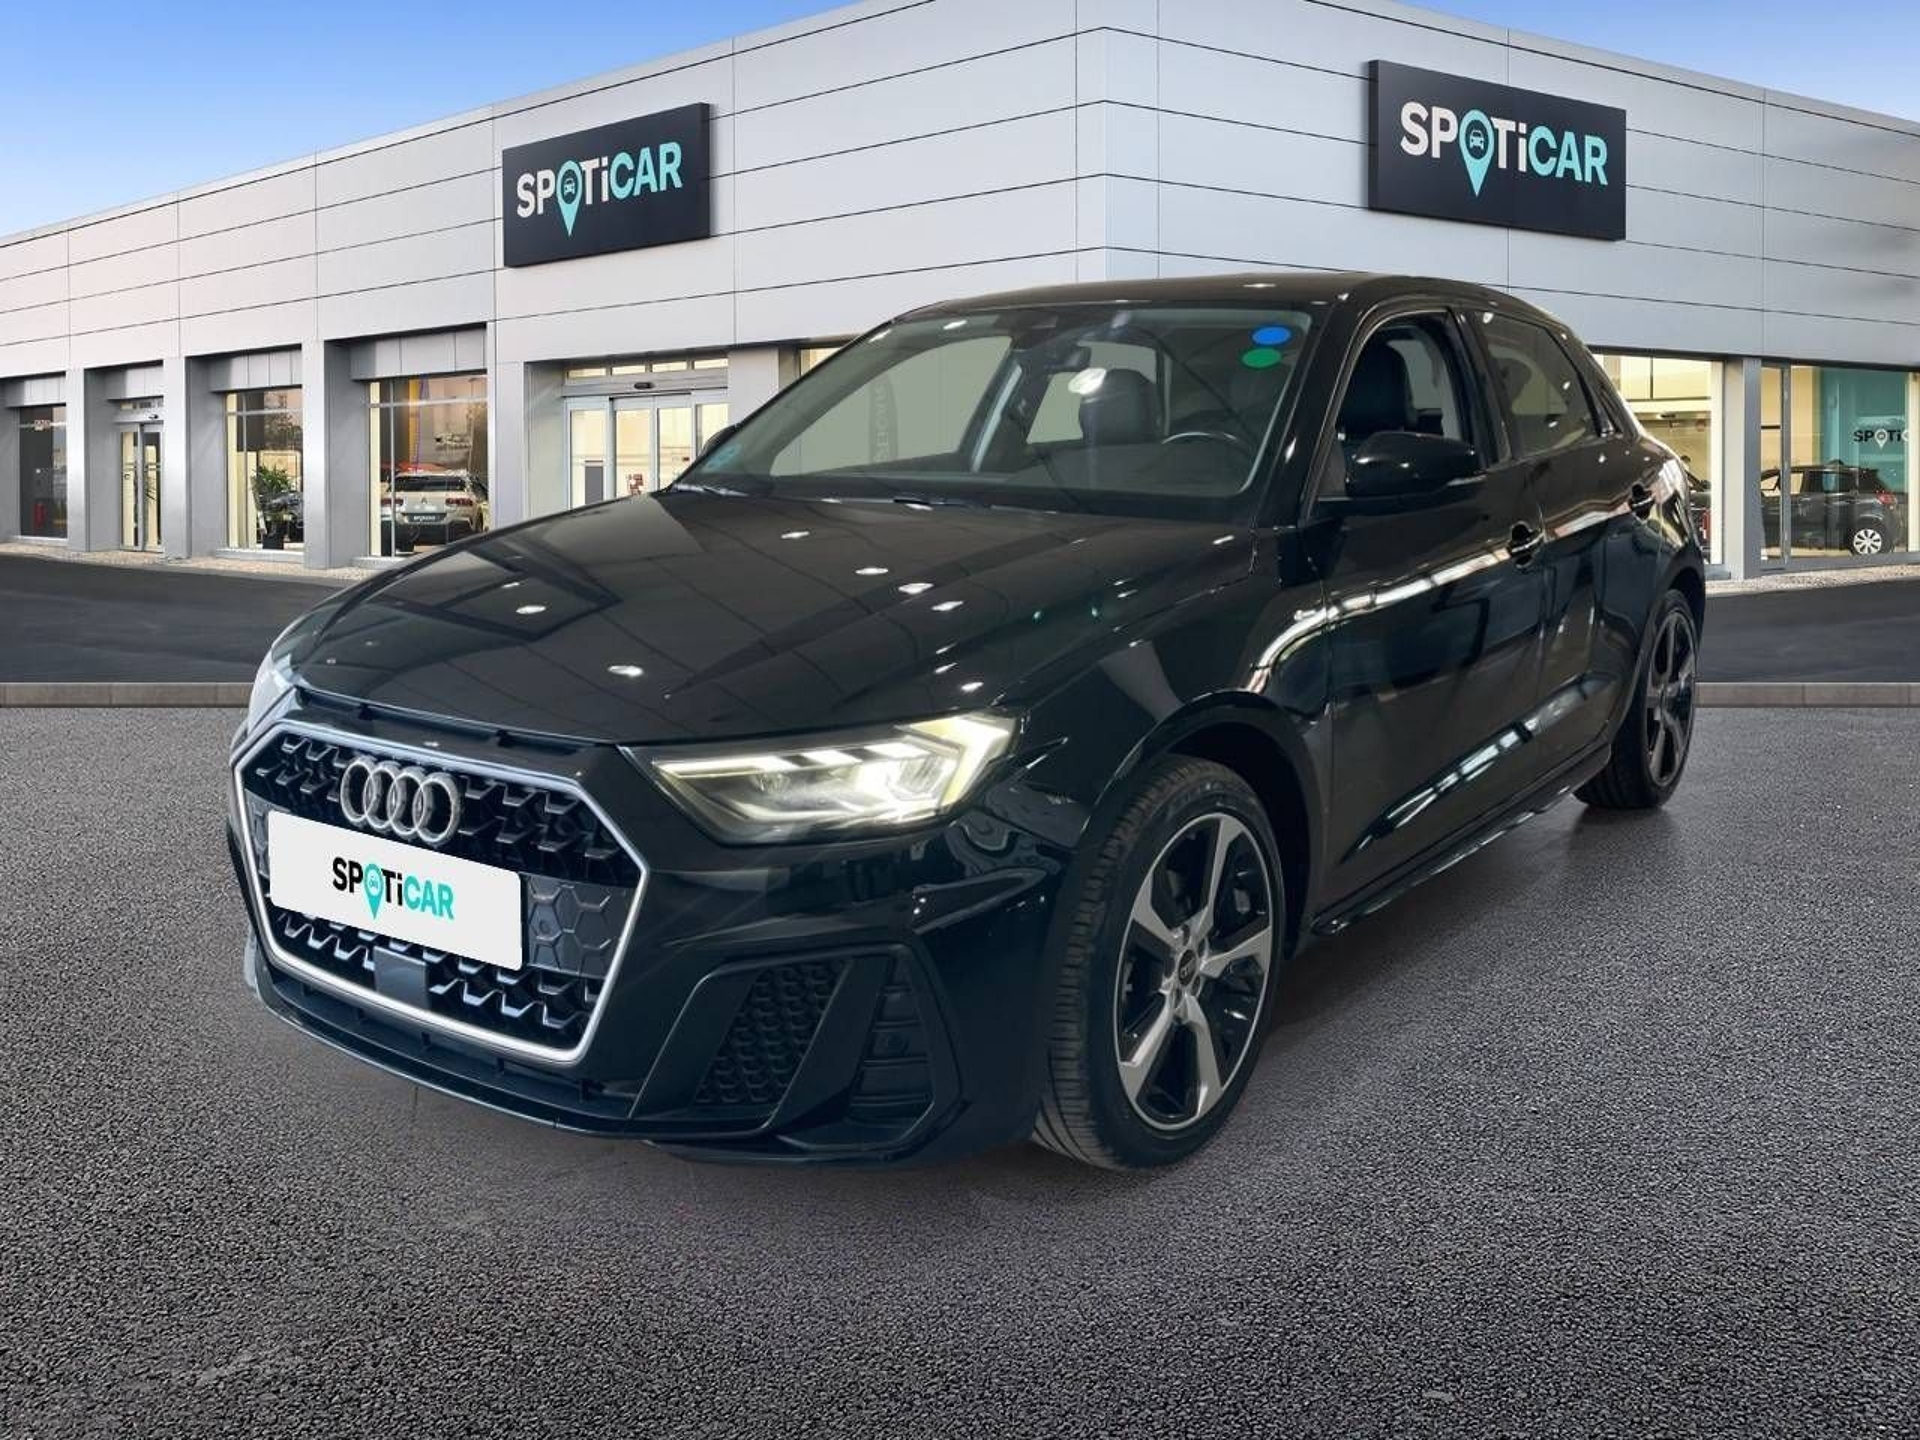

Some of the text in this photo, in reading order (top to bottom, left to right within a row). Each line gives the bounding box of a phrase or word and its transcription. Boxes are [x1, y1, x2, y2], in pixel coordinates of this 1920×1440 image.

[516, 141, 683, 237] SPOTiCAR
[1400, 101, 1608, 198] SPOTiCAR
[332, 857, 454, 920] SPOTiCAR
